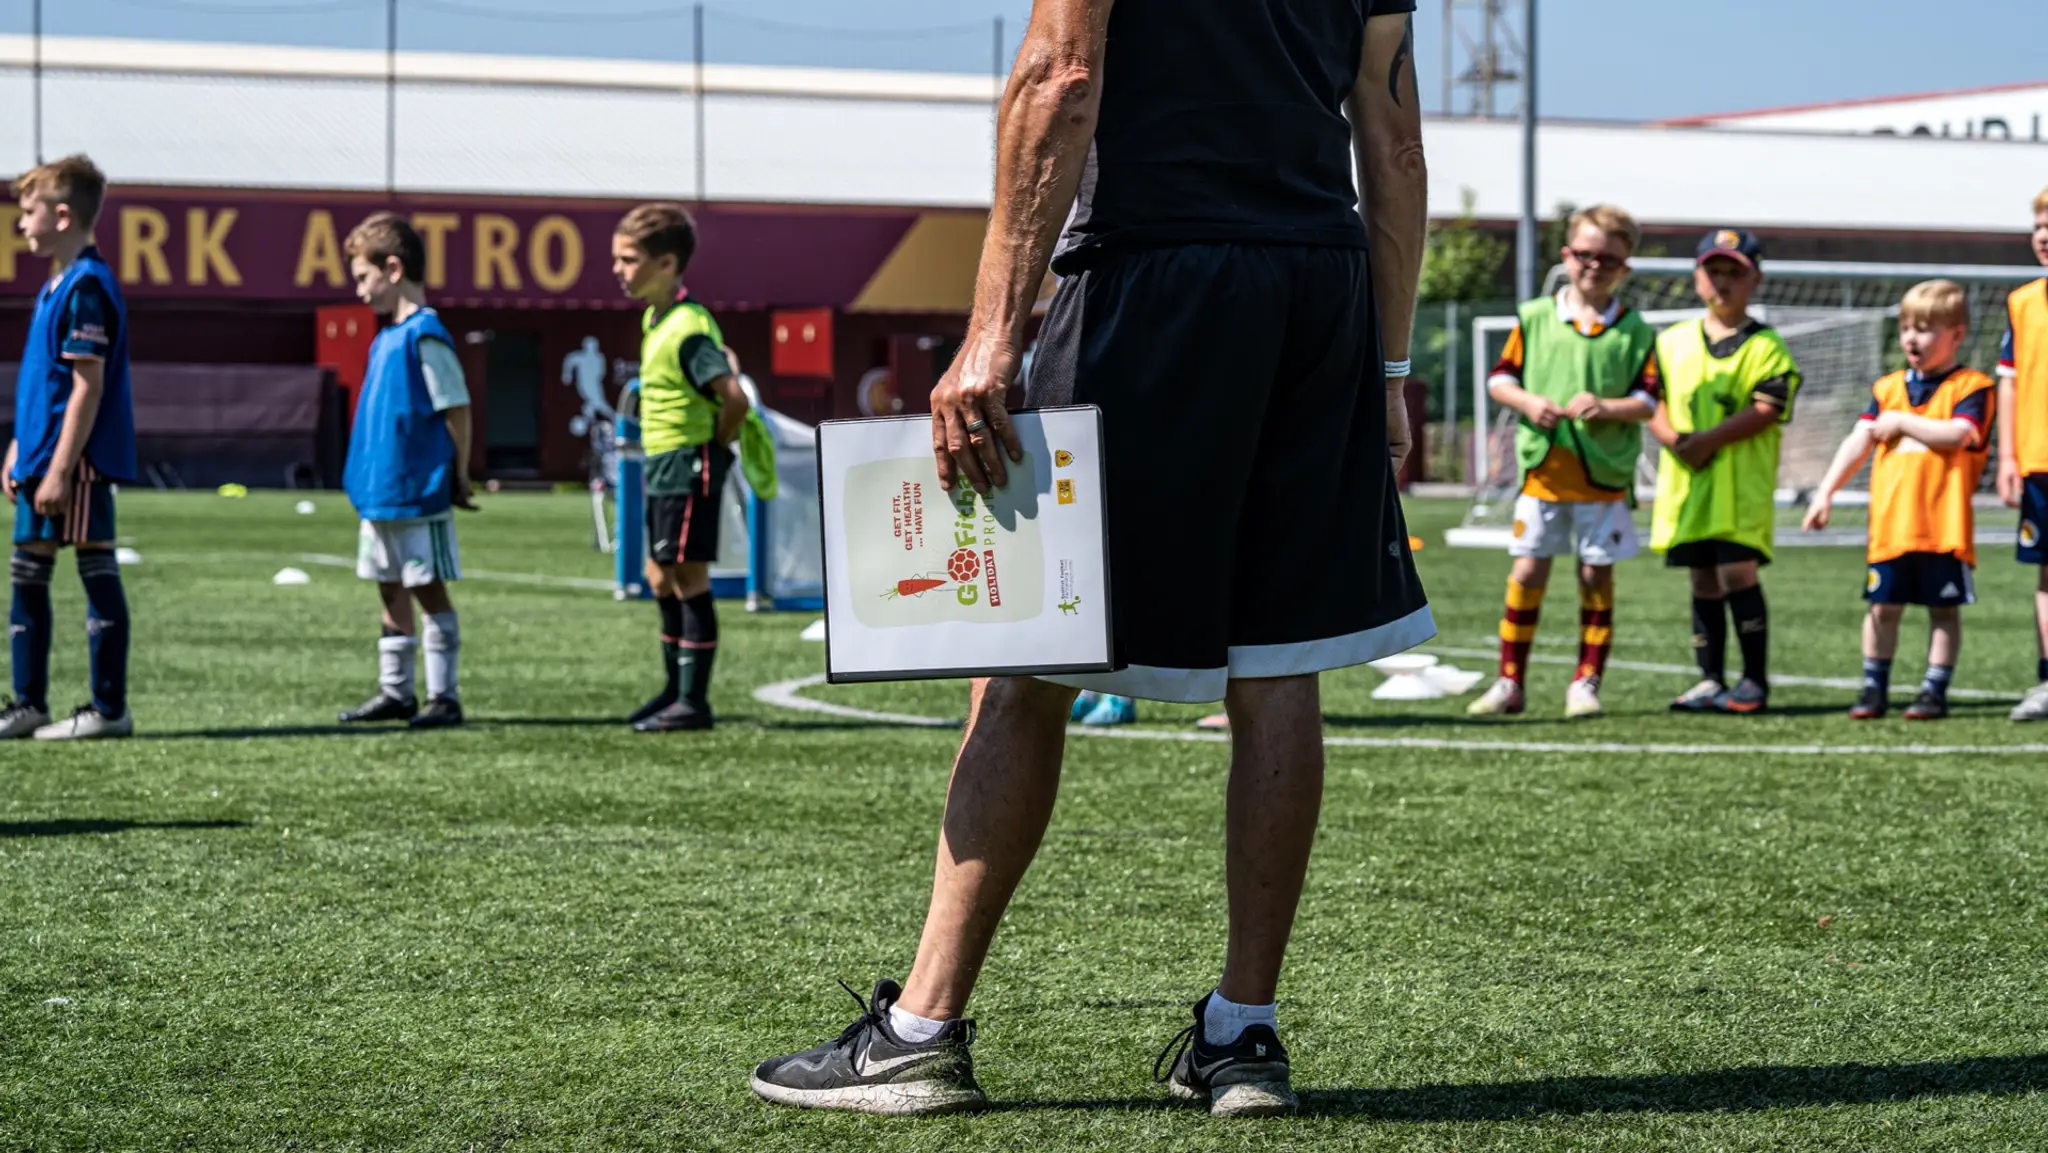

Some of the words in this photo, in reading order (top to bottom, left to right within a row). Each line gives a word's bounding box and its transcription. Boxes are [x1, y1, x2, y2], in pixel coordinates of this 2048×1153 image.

[0, 203, 243, 287] PRK
[294, 209, 585, 293] ATRO
[892, 494, 901, 513] FIT,
[902, 480, 912, 529] HEALTHY
[913, 482, 922, 505] FUN
[894, 516, 902, 537] GET
[914, 508, 923, 535] HAVE
[904, 530, 913, 551] GET
[984, 553, 1000, 604] HOLIDAY
